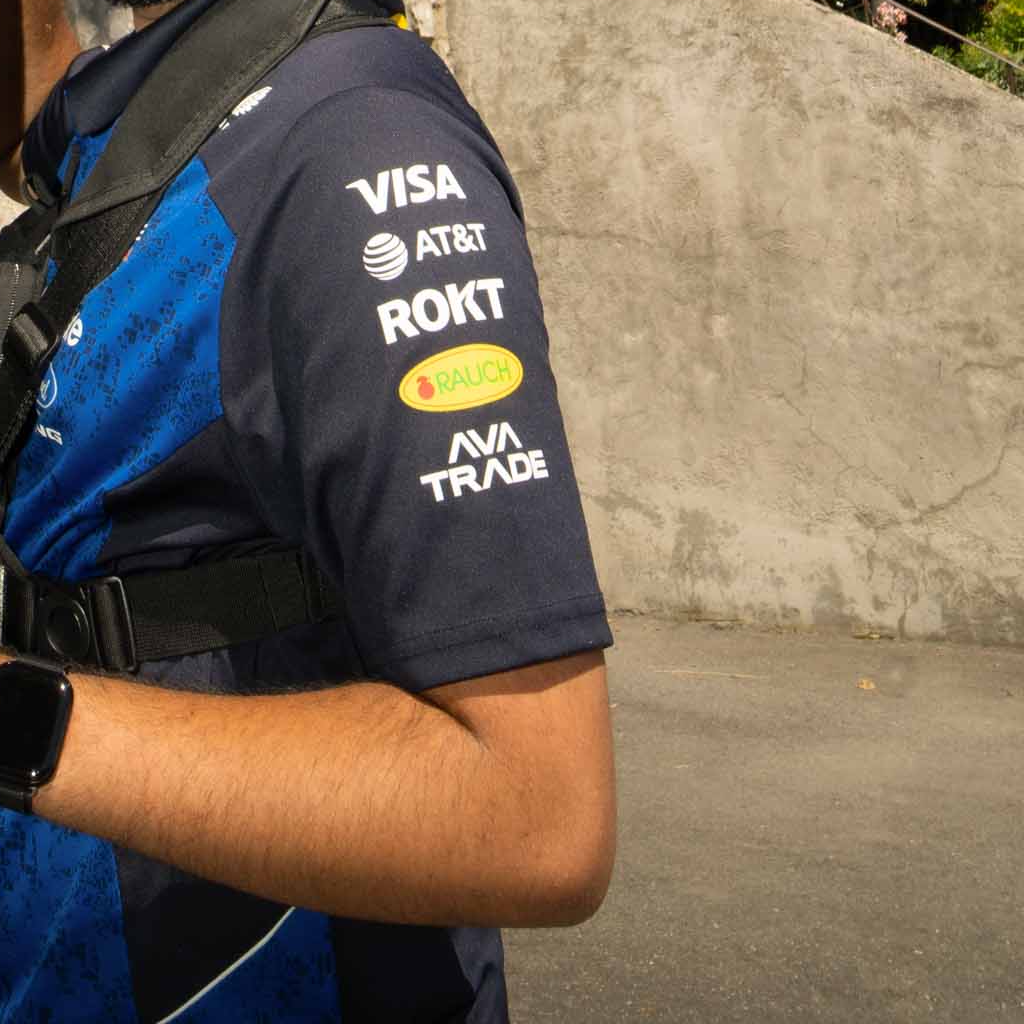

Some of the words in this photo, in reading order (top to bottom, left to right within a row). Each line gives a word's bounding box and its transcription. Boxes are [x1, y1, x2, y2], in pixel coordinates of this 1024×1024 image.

[345, 164, 467, 215] VISA
[416, 223, 488, 262] AT&T
[377, 278, 505, 345] ROKT
[435, 360, 512, 395] RAUCH
[448, 422, 523, 465] AVA
[420, 449, 549, 502] TRADE
